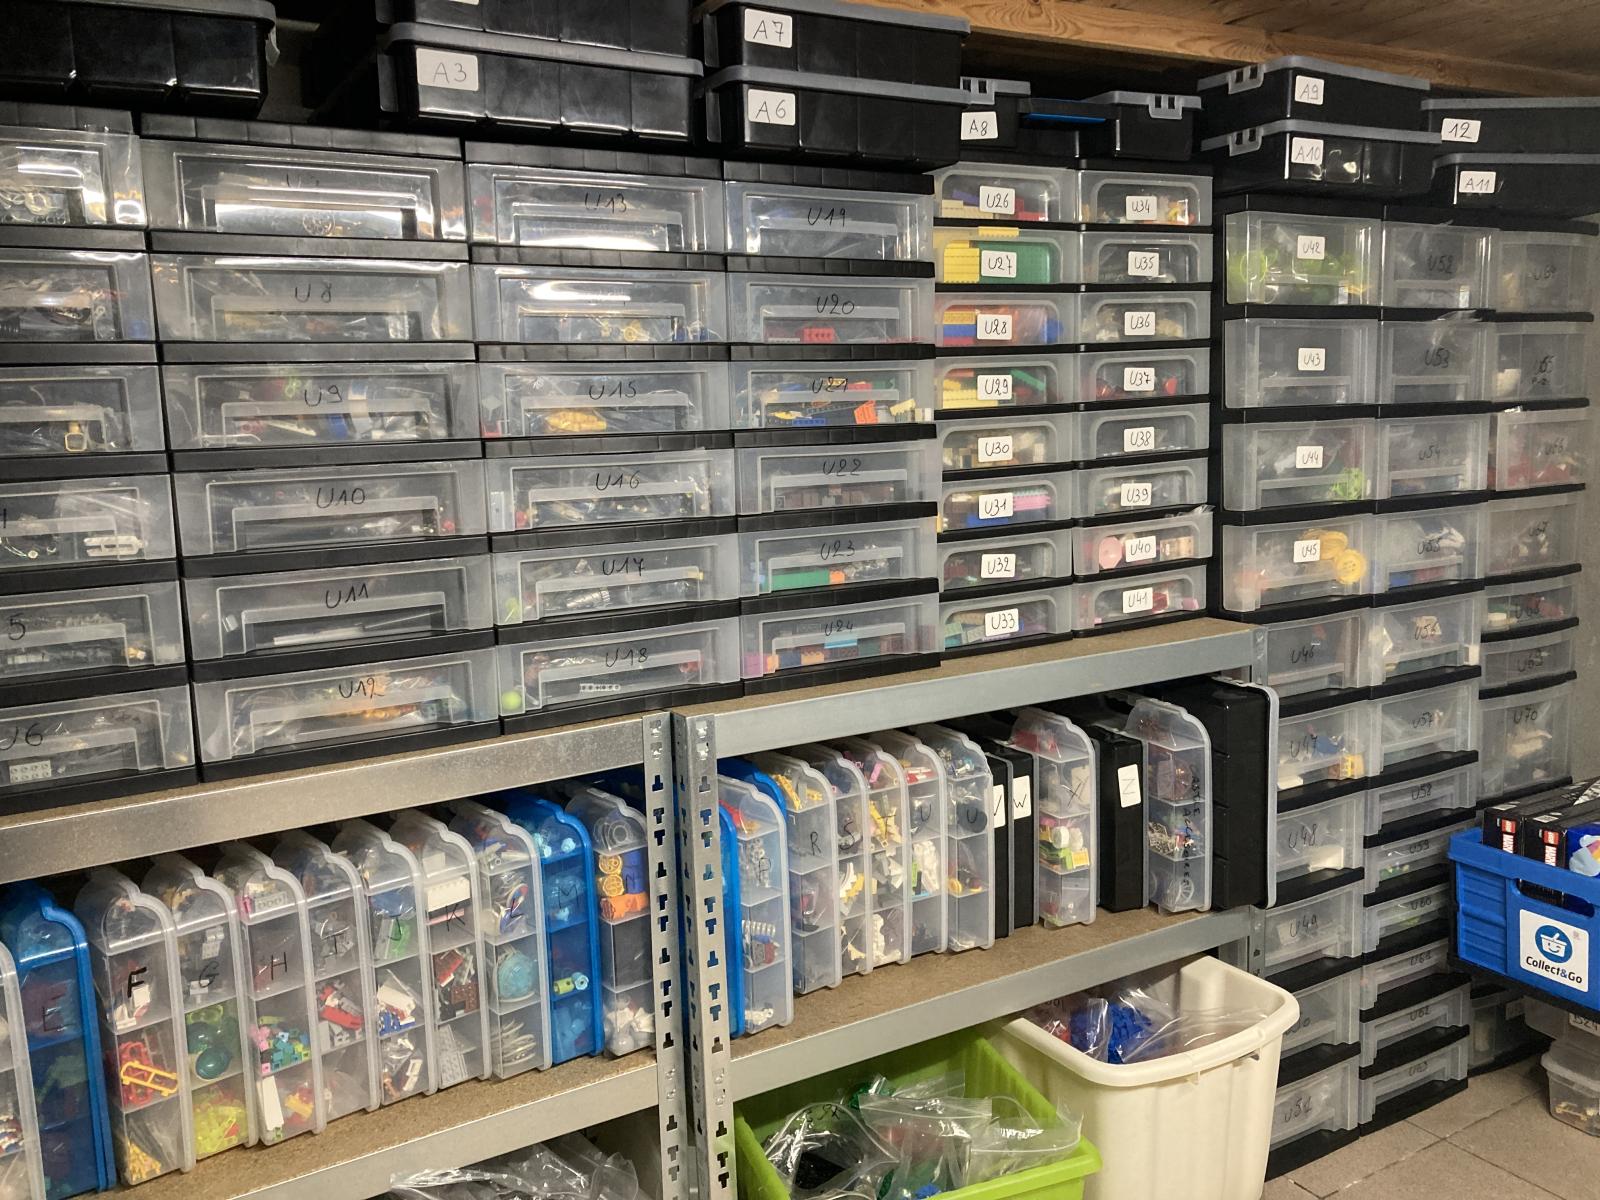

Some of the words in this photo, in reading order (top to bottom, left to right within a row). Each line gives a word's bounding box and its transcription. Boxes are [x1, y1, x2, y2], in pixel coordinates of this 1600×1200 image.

[752, 19, 785, 42] A7
[432, 62, 468, 84] A3
[1299, 82, 1320, 101] A9
[755, 99, 787, 122] A6
[968, 119, 989, 136] A8
[1448, 123, 1470, 140] 12
[1295, 144, 1321, 162] A10
[1464, 177, 1490, 192] A11
[584, 193, 628, 214] U13
[985, 193, 1010, 210] U26
[1131, 199, 1151, 214] U34
[807, 207, 847, 228] U19
[988, 254, 1014, 275] U27
[1134, 255, 1155, 270] U35
[294, 282, 332, 303] U8
[816, 293, 856, 315] U20
[984, 319, 1007, 335] U28
[1131, 314, 1150, 329] U36
[1303, 353, 1321, 367] U43
[984, 378, 1009, 395] U29
[1129, 370, 1152, 386] U37
[304, 384, 343, 408] U9
[588, 381, 637, 400] U15
[1130, 430, 1152, 447] U38
[985, 442, 1010, 457] U30
[822, 458, 862, 477] U22
[595, 469, 641, 491] U16
[316, 486, 366, 509] U10
[1126, 486, 1149, 503] U39
[984, 500, 1008, 517] U31
[821, 539, 856, 561] U23
[1130, 540, 1151, 556] U40
[1301, 543, 1318, 559] U45
[602, 556, 645, 577] U17
[987, 557, 1011, 574] U32
[325, 582, 370, 610] U11
[1127, 593, 1148, 607] U41
[825, 619, 854, 637] U24
[991, 613, 1016, 630] U33
[605, 647, 649, 669] U18
[338, 677, 385, 699] U12
[1513, 705, 1539, 724] U70
[1120, 777, 1137, 796] Z
[1013, 793, 1027, 809] W
[919, 803, 933, 823] U
[966, 808, 979, 825] U
[838, 820, 855, 851] S
[877, 812, 897, 841] T
[809, 830, 822, 857] R
[558, 884, 579, 909] M
[446, 902, 466, 932] K
[510, 896, 524, 919] L
[386, 913, 403, 942] J
[197, 961, 221, 988] G
[269, 951, 288, 981] H
[1525, 955, 1583, 984] Collect&Go
[126, 965, 148, 999] F
[41, 1005, 67, 1032] E
